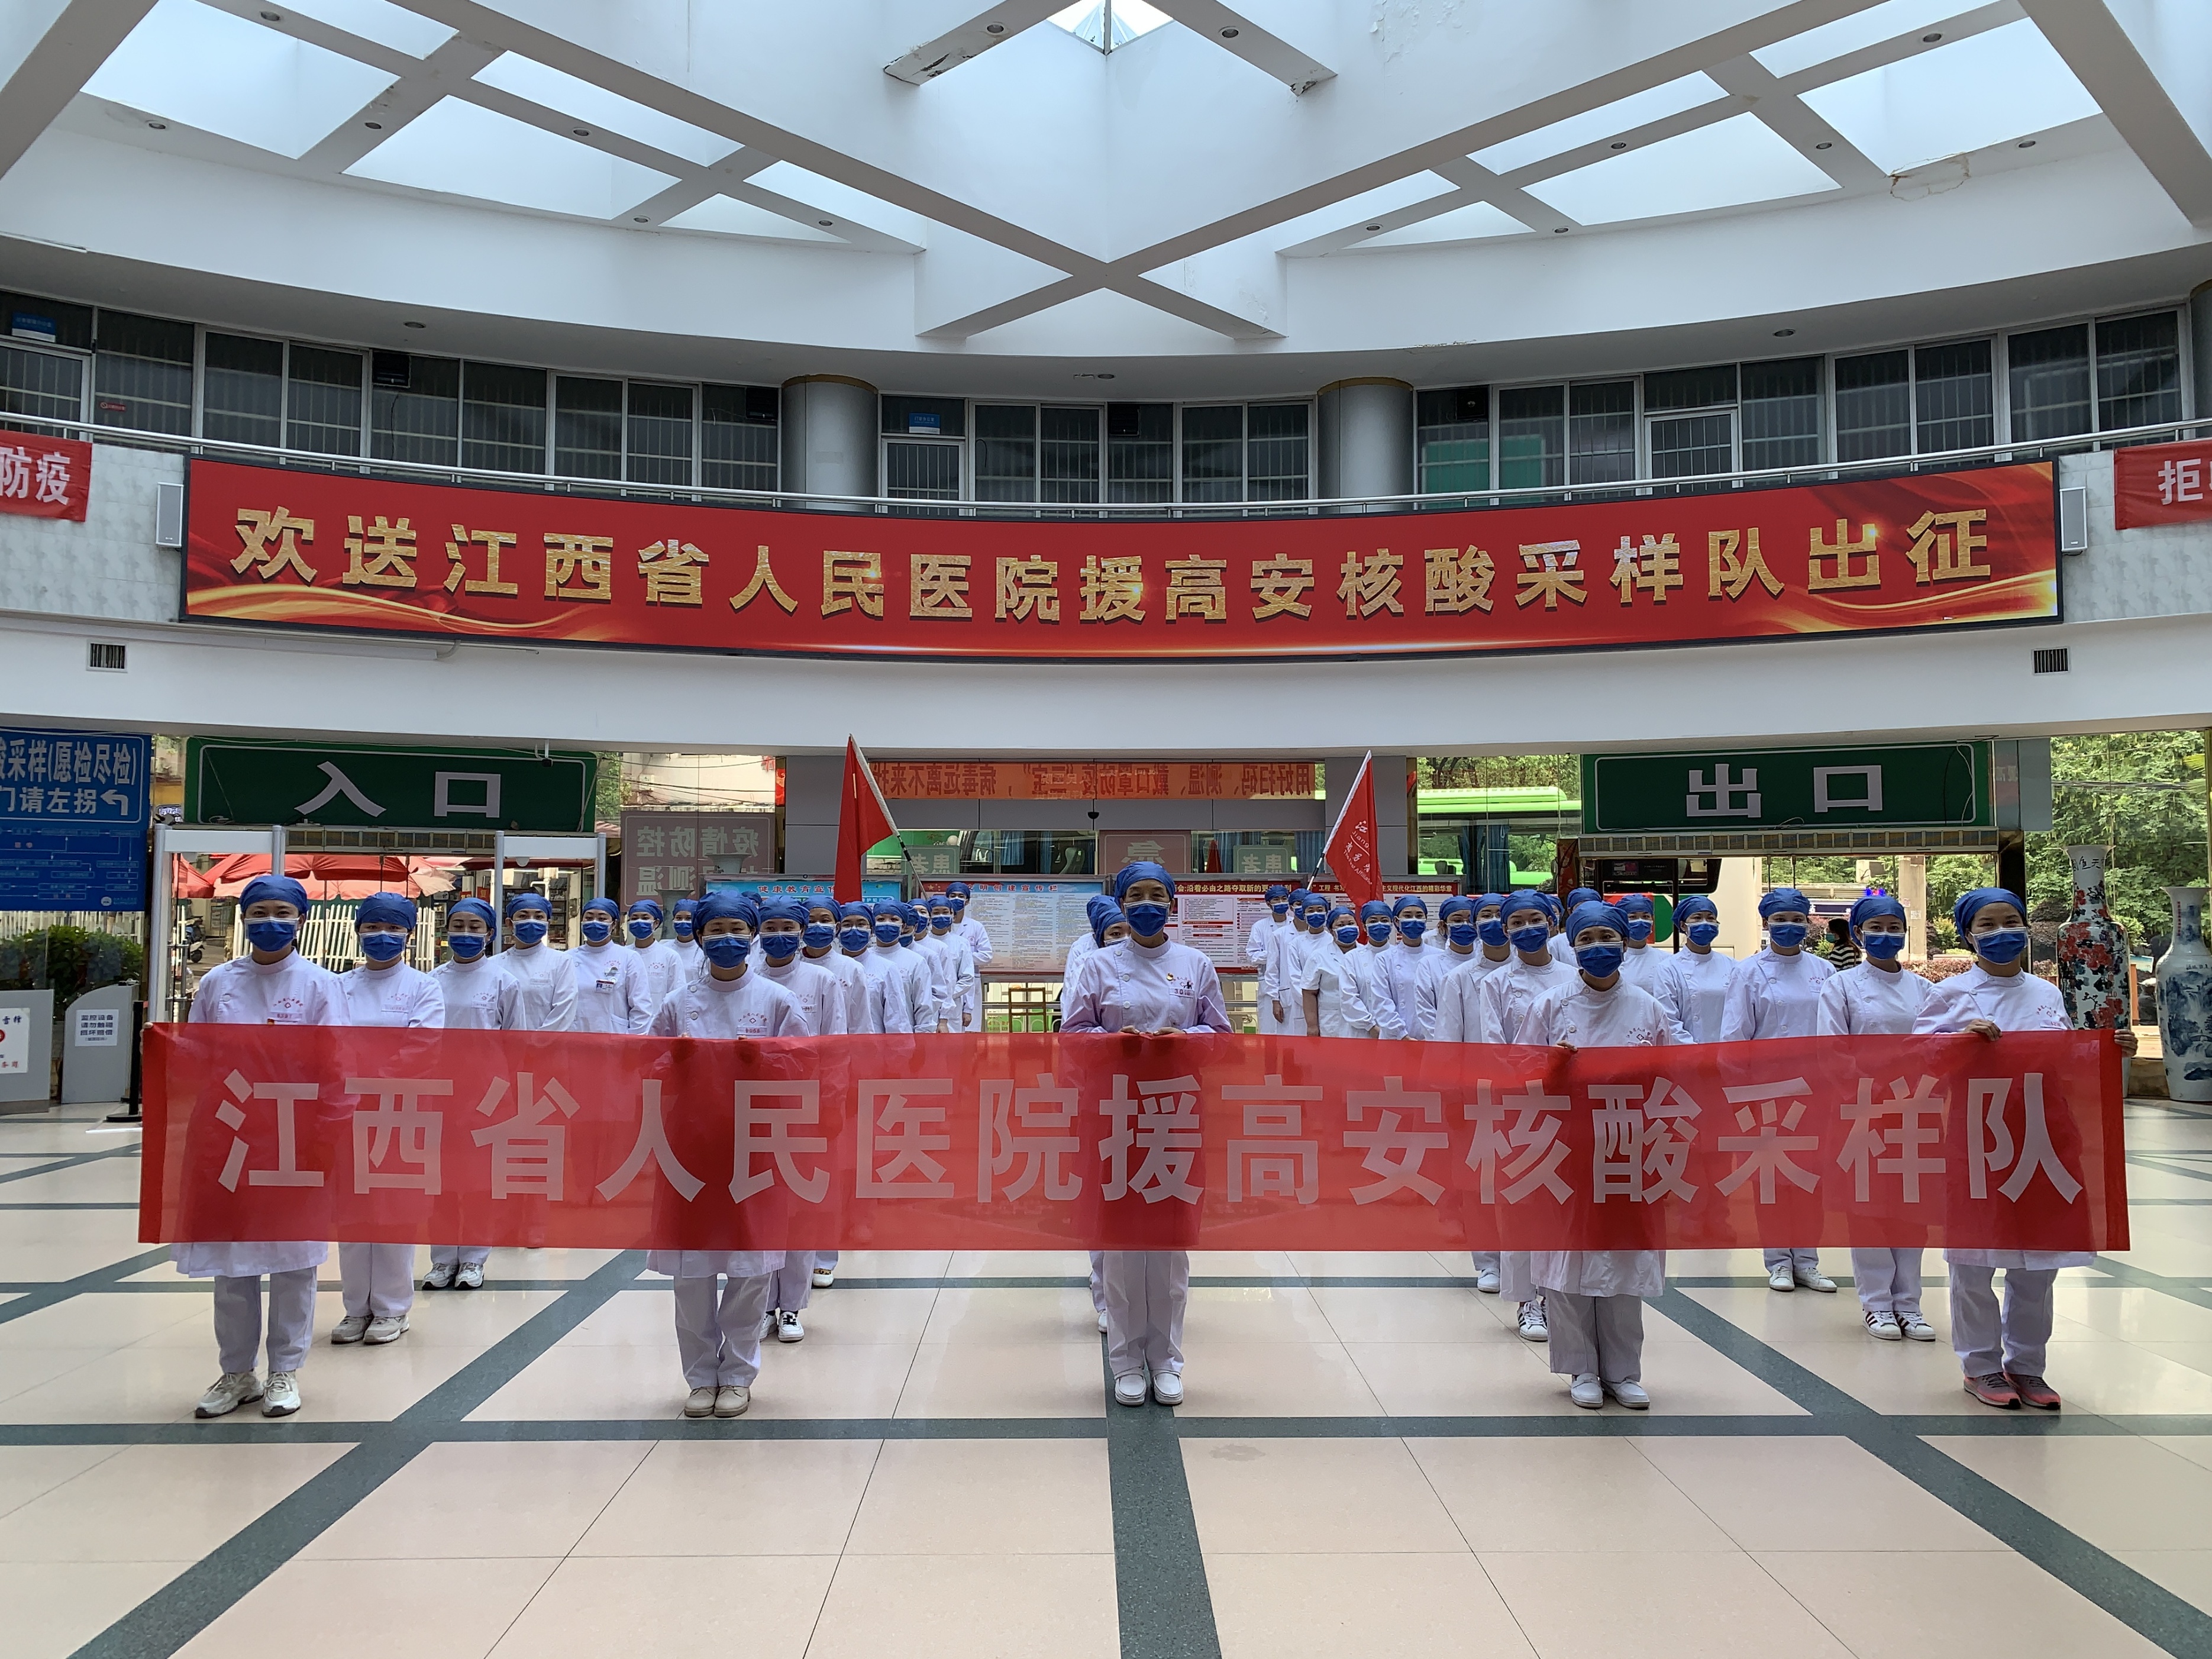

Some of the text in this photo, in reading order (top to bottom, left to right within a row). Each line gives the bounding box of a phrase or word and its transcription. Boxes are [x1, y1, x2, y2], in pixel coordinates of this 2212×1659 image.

[0, 447, 70, 505] 防疫
[2158, 458, 2212, 505] 拒
[230, 506, 1991, 622] 欢送江西省人民医院援高安核酸采样队出征
[294, 761, 502, 818] 入口
[1686, 763, 1883, 818] 出口
[216, 1072, 2084, 1206] 江西省人民医院援高安核酸采样队
